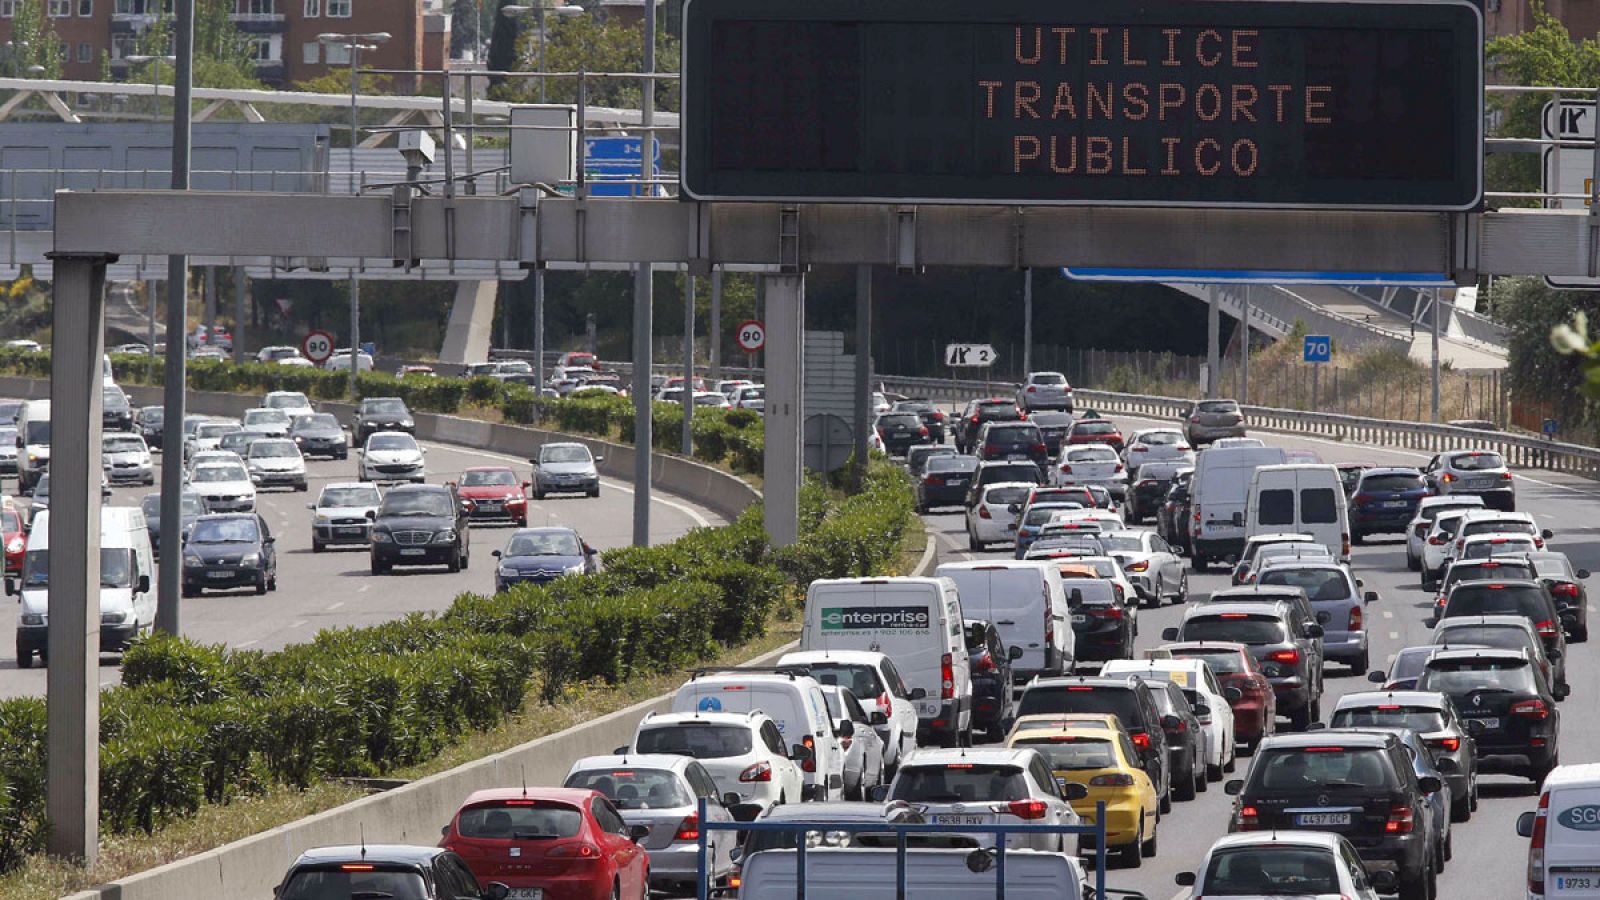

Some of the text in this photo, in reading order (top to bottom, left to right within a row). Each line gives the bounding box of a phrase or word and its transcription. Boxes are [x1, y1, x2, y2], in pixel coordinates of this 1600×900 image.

[1015, 27, 1258, 67] UTILICE
[979, 81, 1333, 124] TRANSPORTE
[1014, 135, 1258, 176] PUBLICO
[743, 331, 761, 342] 90
[309, 341, 328, 353] 90
[1307, 343, 1328, 356] 70
[979, 350, 988, 361] 2
[823, 610, 927, 625] enterprise
[1564, 878, 1590, 889] 9733
